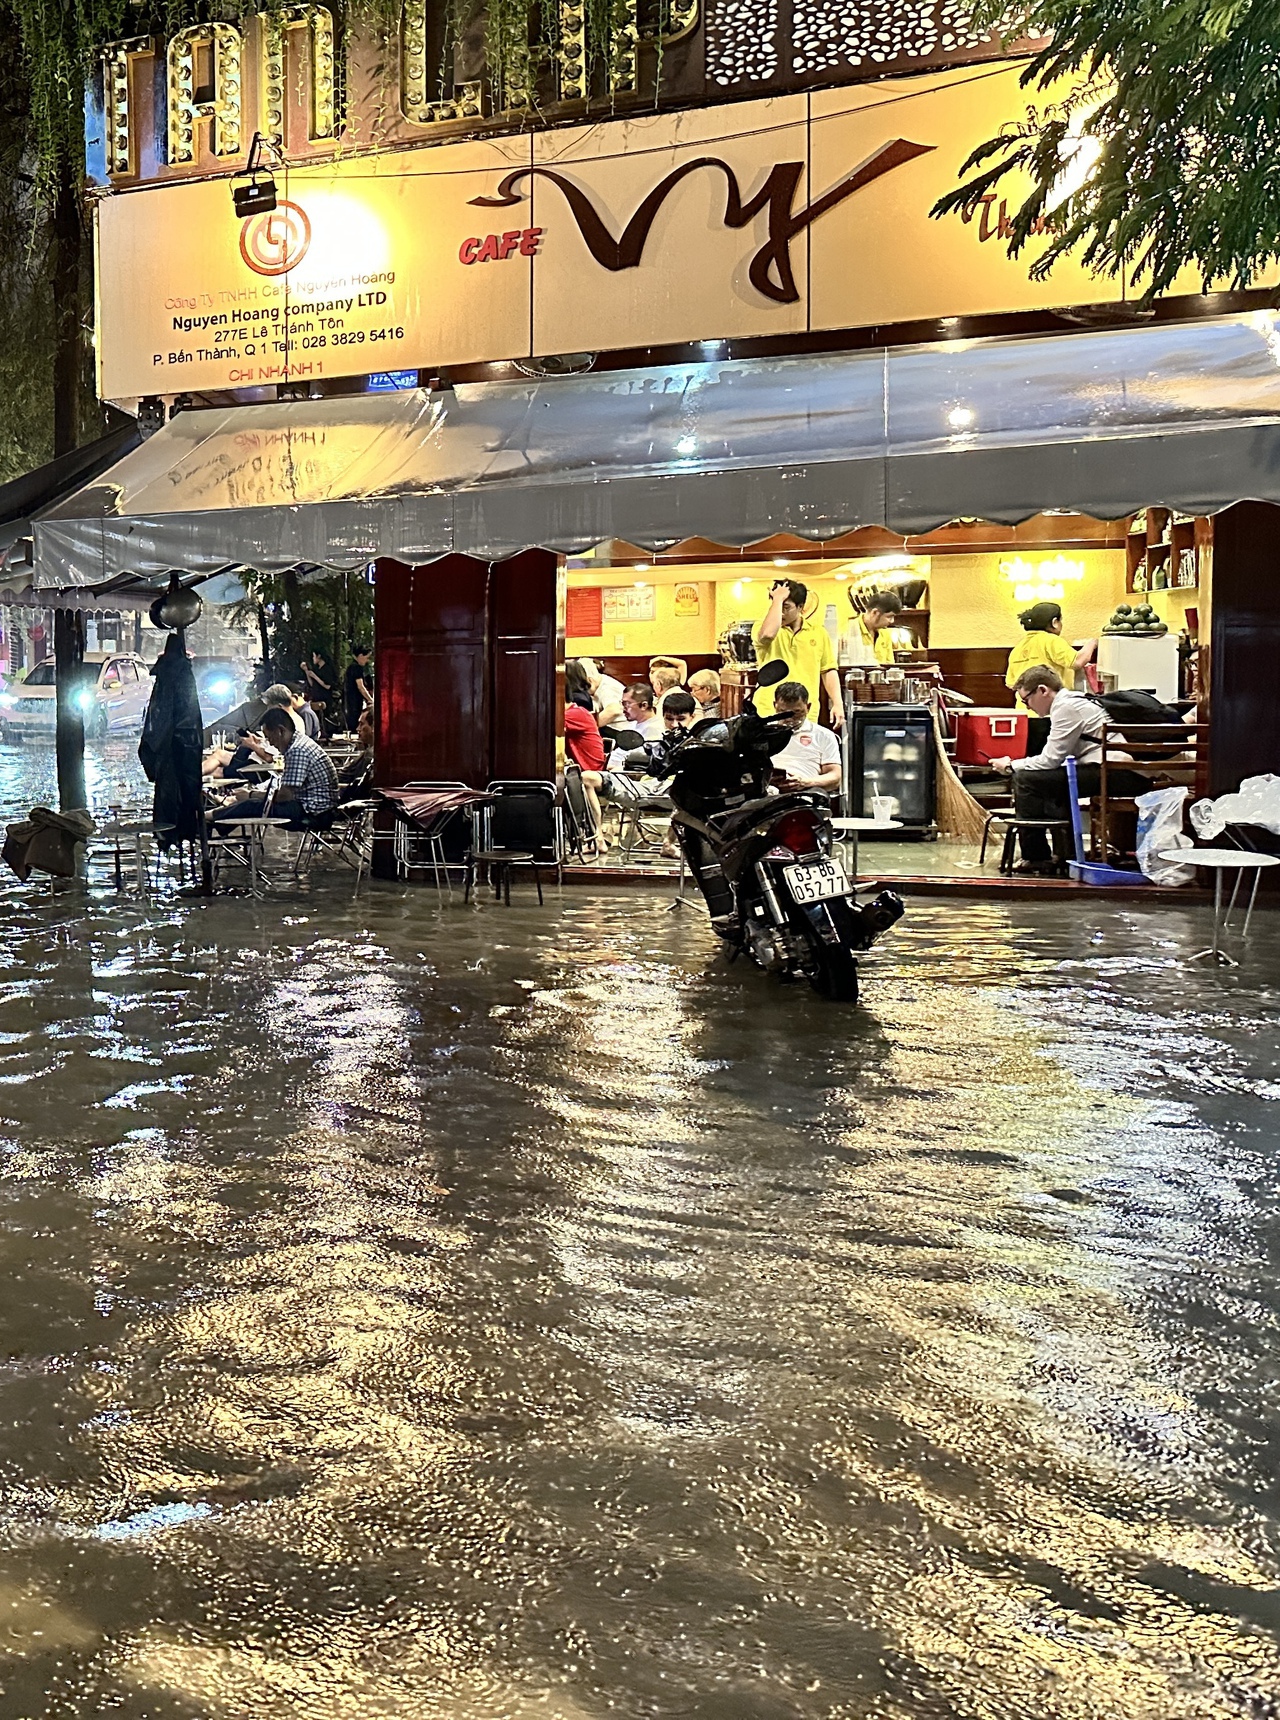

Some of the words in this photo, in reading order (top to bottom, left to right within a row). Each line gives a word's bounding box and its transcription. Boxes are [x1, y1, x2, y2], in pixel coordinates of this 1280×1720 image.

[458, 227, 543, 265] CAFE
[217, 286, 257, 303] TNHH
[172, 313, 228, 332] Nguyen
[231, 306, 280, 323] Hoang
[284, 298, 354, 316] company
[357, 291, 388, 308] LTD
[214, 327, 248, 343] 277E
[252, 325, 268, 339] Lê
[271, 320, 314, 336] Thánh
[318, 317, 345, 331] Tôn
[153, 353, 164, 366] P.
[168, 348, 193, 365] Bến
[196, 345, 241, 362] Thành,
[244, 343, 256, 356] Q
[260, 342, 267, 355] 1
[302, 335, 328, 349] 028
[331, 330, 365, 346] 3829
[369, 326, 405, 342] 5416
[228, 367, 254, 382] CHI
[316, 360, 324, 374] 1
[793, 861, 835, 882] 63-B6
